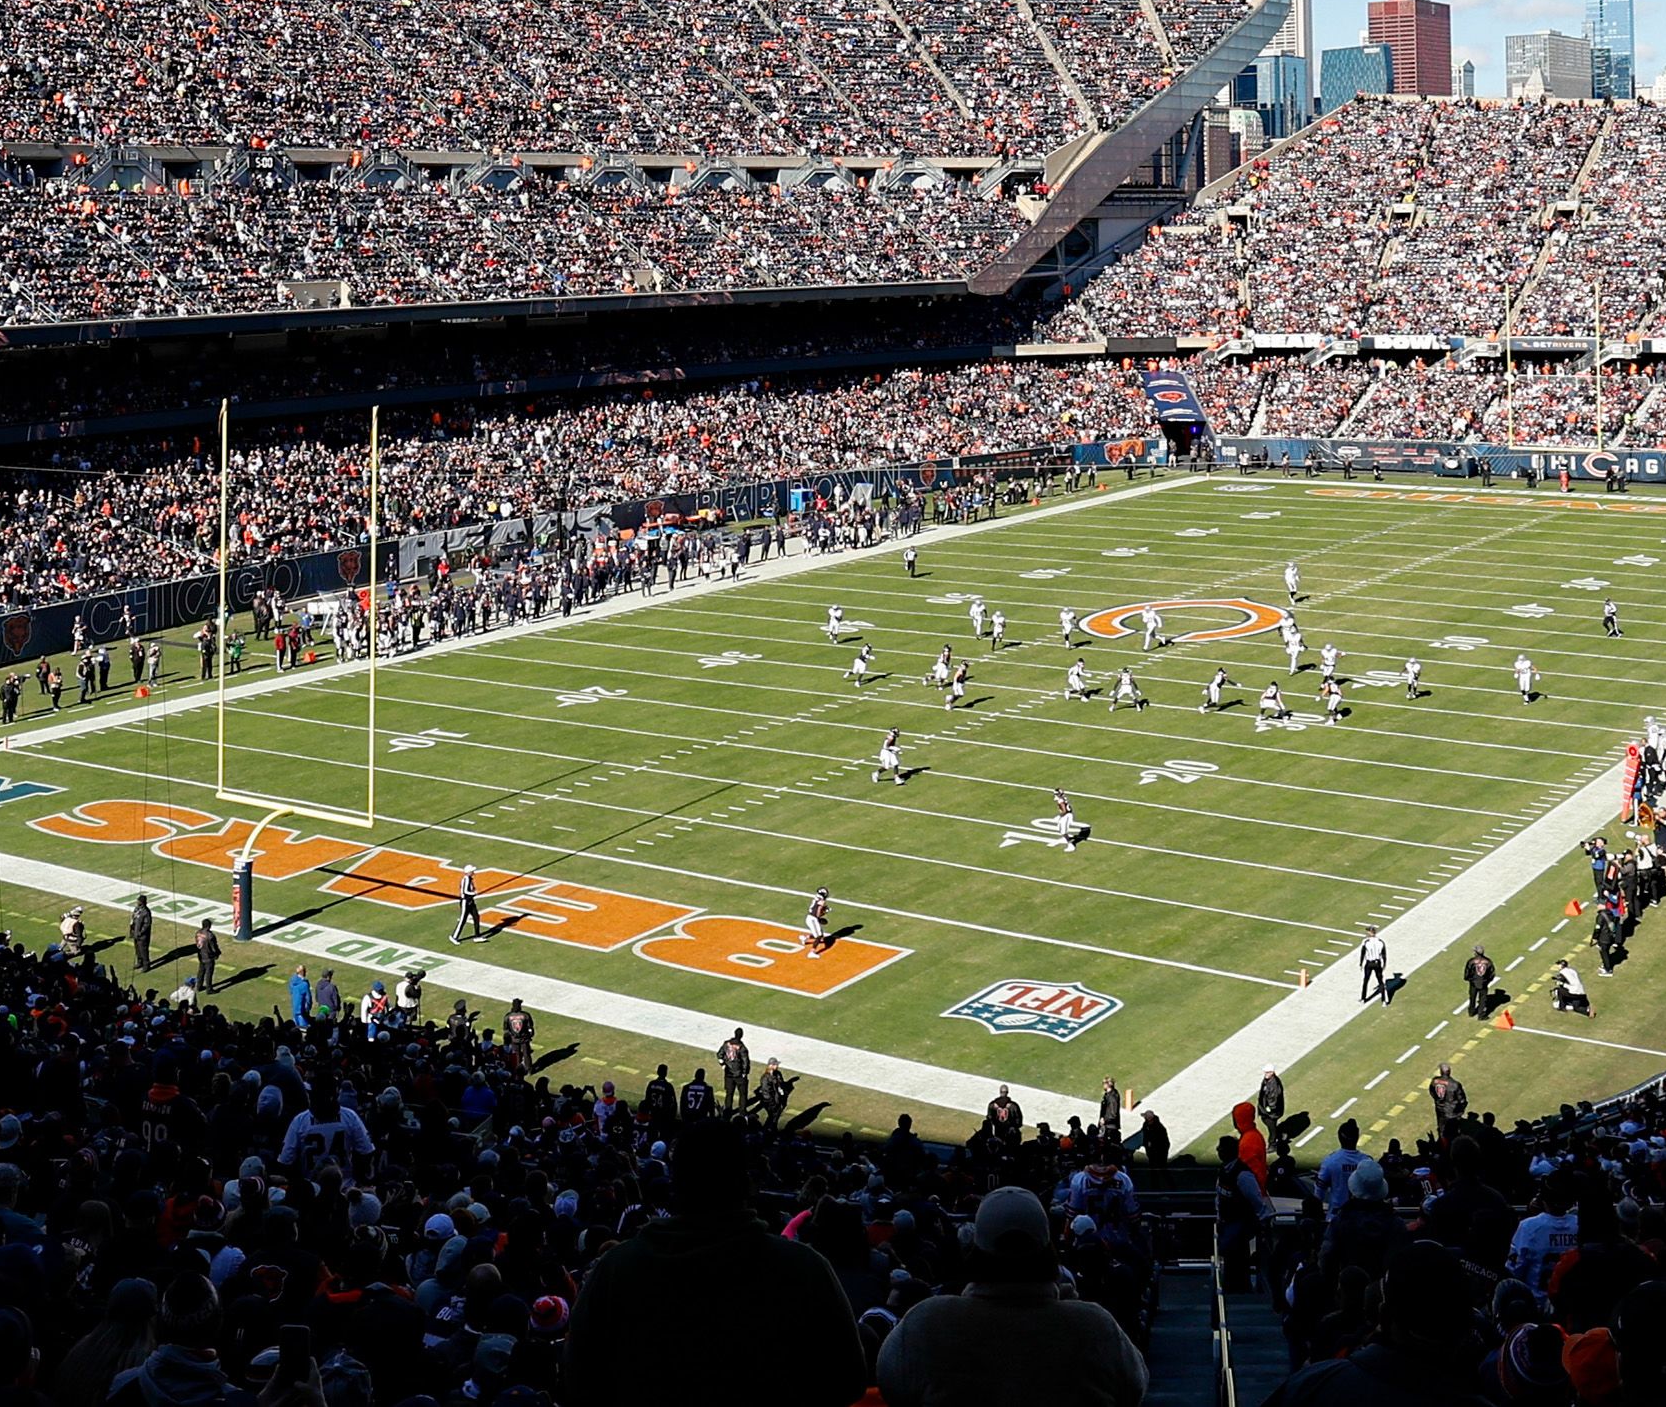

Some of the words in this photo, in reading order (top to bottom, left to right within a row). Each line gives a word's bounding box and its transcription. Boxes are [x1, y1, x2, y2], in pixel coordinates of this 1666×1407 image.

[255, 157, 273, 168] 5:00
[1254, 335, 1320, 348] BEAR
[82, 559, 301, 638] CHICAGO
[697, 651, 763, 666] 30
[555, 686, 629, 704] 20
[389, 728, 470, 749] 10
[1139, 760, 1220, 784] 20
[26, 799, 915, 999] BEARS
[325, 937, 451, 973] END
[999, 985, 1103, 1020] NFL
[687, 1091, 705, 1110] 57
[1459, 1258, 1498, 1282] CHICAGO
